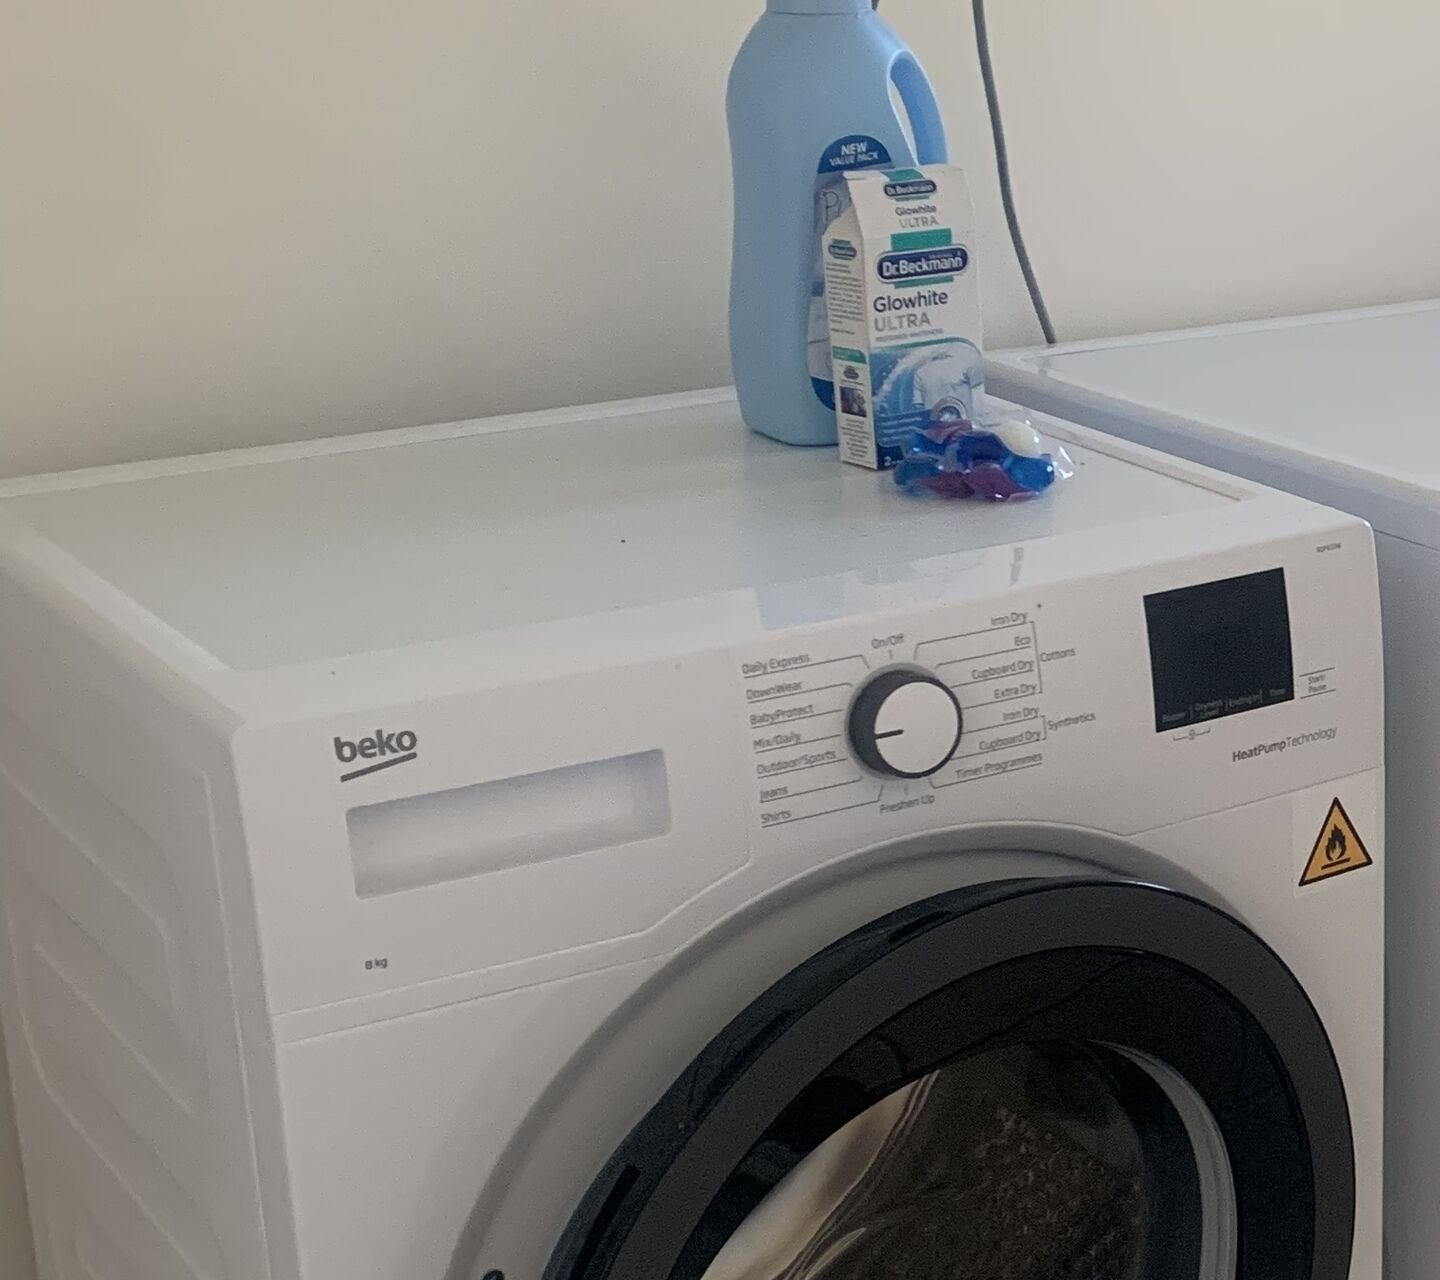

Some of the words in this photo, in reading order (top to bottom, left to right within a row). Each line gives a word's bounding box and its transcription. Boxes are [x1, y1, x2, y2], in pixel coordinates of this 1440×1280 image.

[841, 141, 867, 155] NEW
[895, 204, 936, 216] Glowhite
[899, 216, 939, 228] ULTRA
[873, 290, 948, 313] Glowhite
[874, 312, 930, 332] ULTRA
[1010, 612, 1028, 624] Dry
[871, 633, 905, 649] On/Off
[1014, 635, 1031, 646] Eco
[1040, 647, 1076, 663] Cottons
[742, 660, 768, 675] Daily
[769, 653, 810, 670] Express
[972, 662, 1016, 680] Cupboard
[1017, 659, 1035, 671] Dry
[994, 687, 1019, 699] Extra
[1020, 683, 1037, 696] Dry
[1003, 711, 1021, 721] Iron
[1023, 707, 1040, 719] Dry
[1048, 712, 1096, 731] Synthetics
[333, 728, 417, 763] beko
[979, 733, 1023, 751] Cupboard
[1024, 730, 1041, 742] Dry
[1232, 727, 1337, 762] HeatPumpTechnology
[955, 764, 983, 778] Timer
[985, 752, 1043, 772] Programmes
[760, 786, 788, 800] Jeans
[921, 794, 935, 806] Up
[761, 809, 792, 824] Shirts
[364, 958, 373, 971] 8
[374, 956, 388, 969] kg
